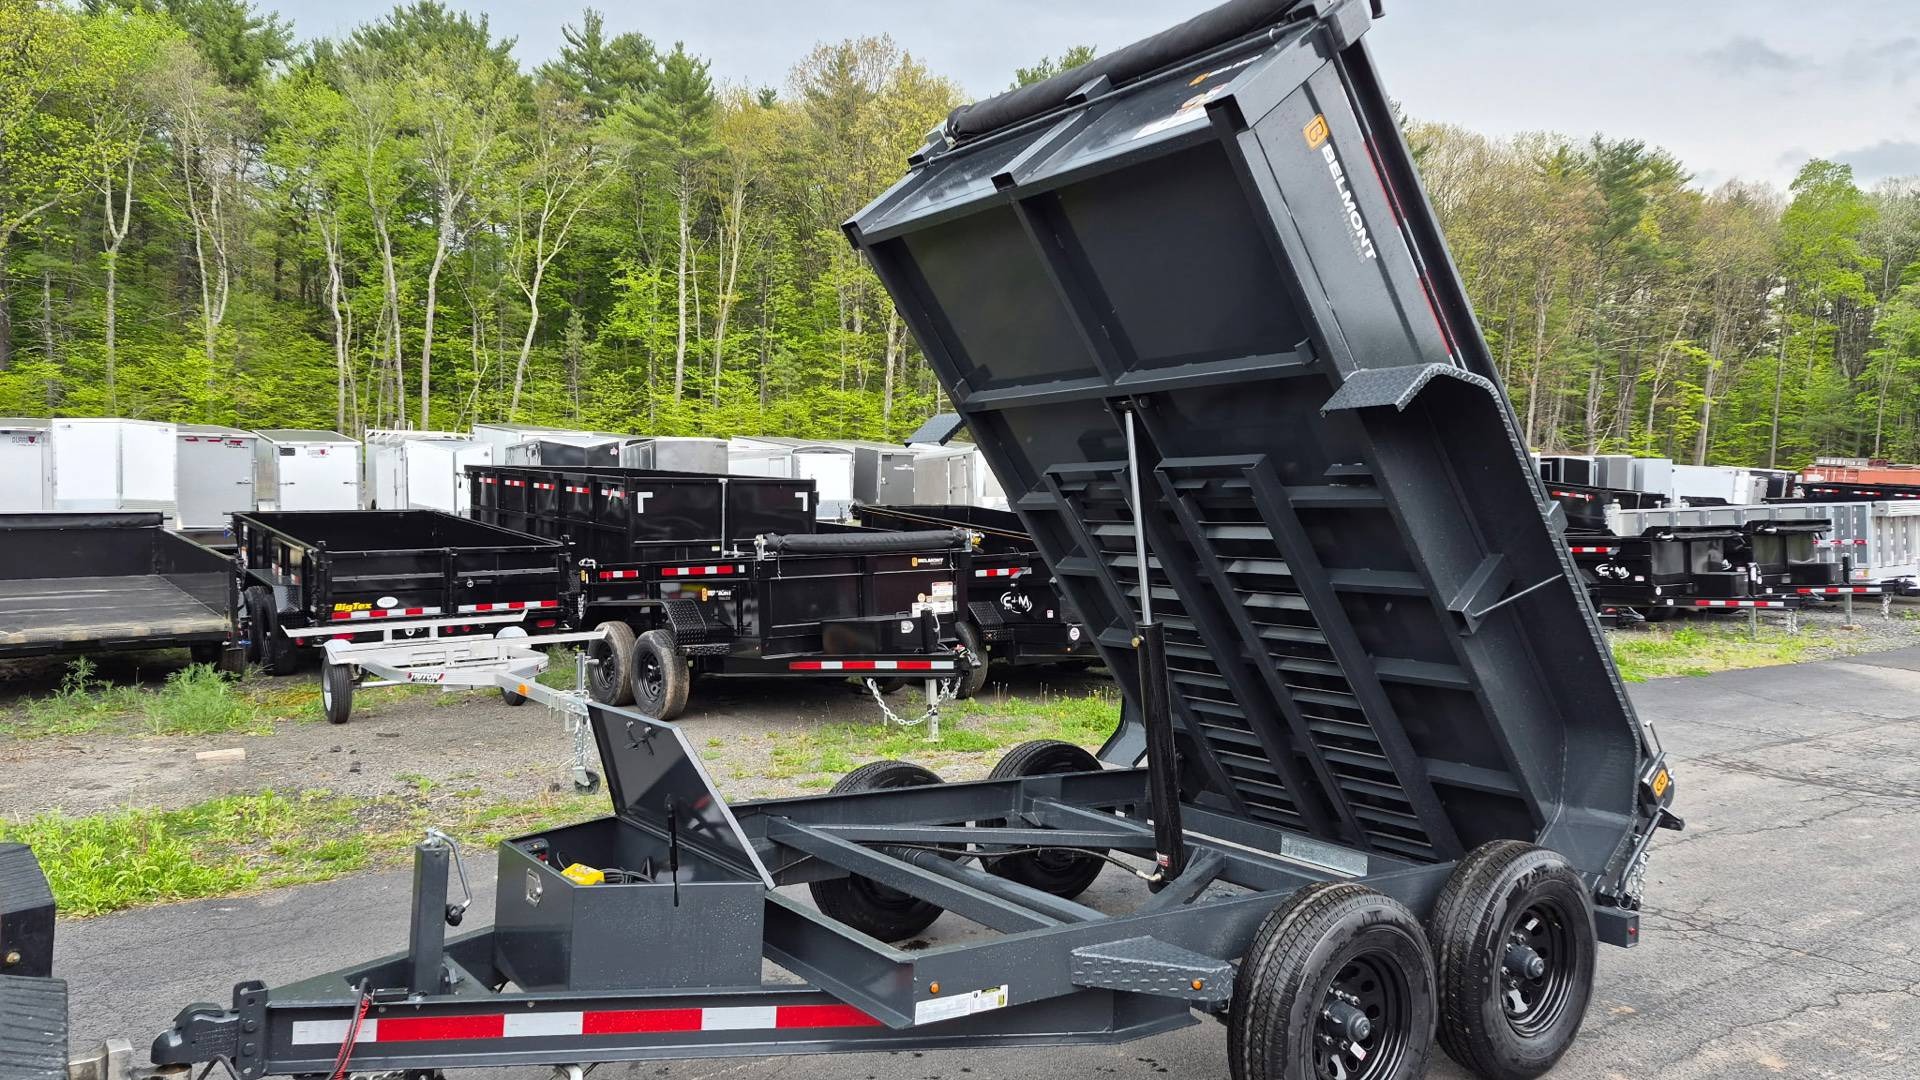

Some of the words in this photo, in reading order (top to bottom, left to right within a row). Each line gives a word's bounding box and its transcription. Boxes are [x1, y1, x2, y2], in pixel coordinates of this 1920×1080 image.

[1321, 143, 1377, 259] BELMONT
[333, 602, 373, 612] BigTex
[411, 672, 441, 680] TRITON
